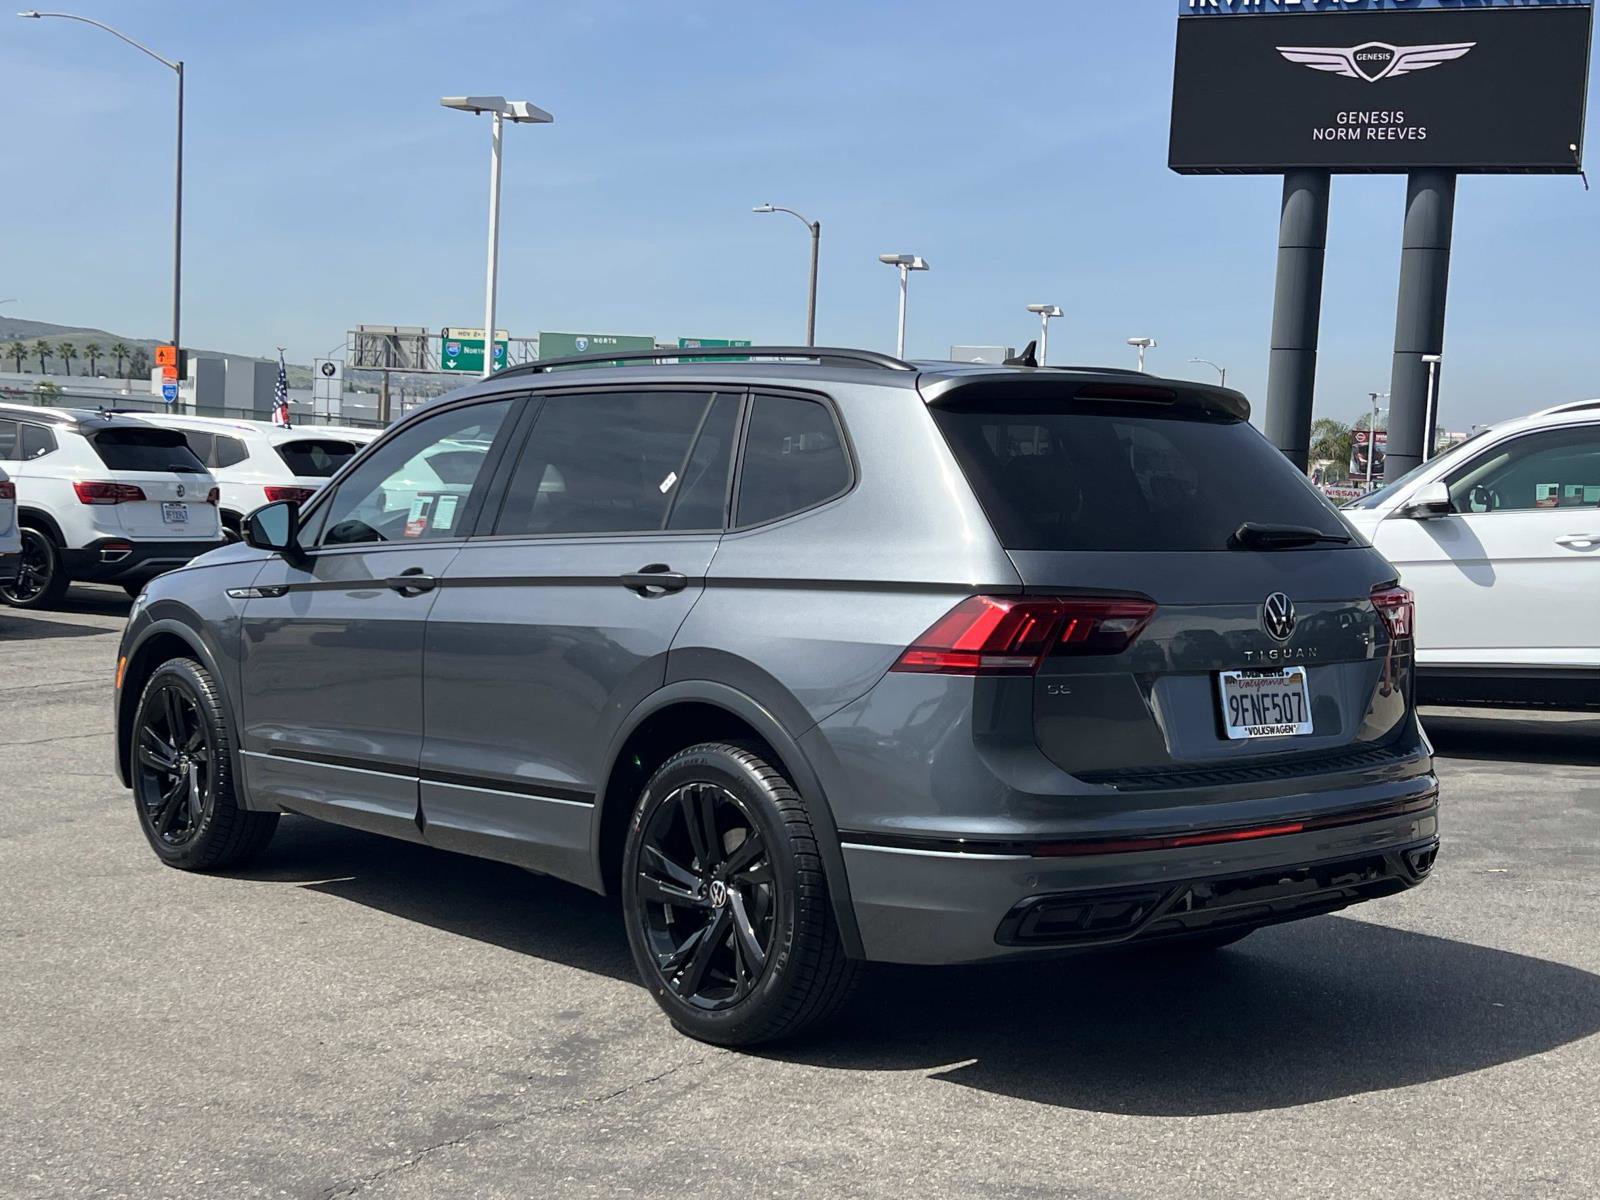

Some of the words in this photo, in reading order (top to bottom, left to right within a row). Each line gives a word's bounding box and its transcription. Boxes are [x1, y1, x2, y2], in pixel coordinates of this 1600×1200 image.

[1356, 52, 1391, 61] GENESIS
[1336, 111, 1404, 124] GENESIS
[1313, 127, 1361, 140] NORM
[1366, 126, 1427, 140] REEVES
[579, 341, 585, 349] 5
[593, 337, 617, 345] NORTH
[1325, 489, 1360, 498] NISSAN
[1244, 647, 1319, 661] TIGUAN
[1229, 692, 1302, 727] 9FNF507
